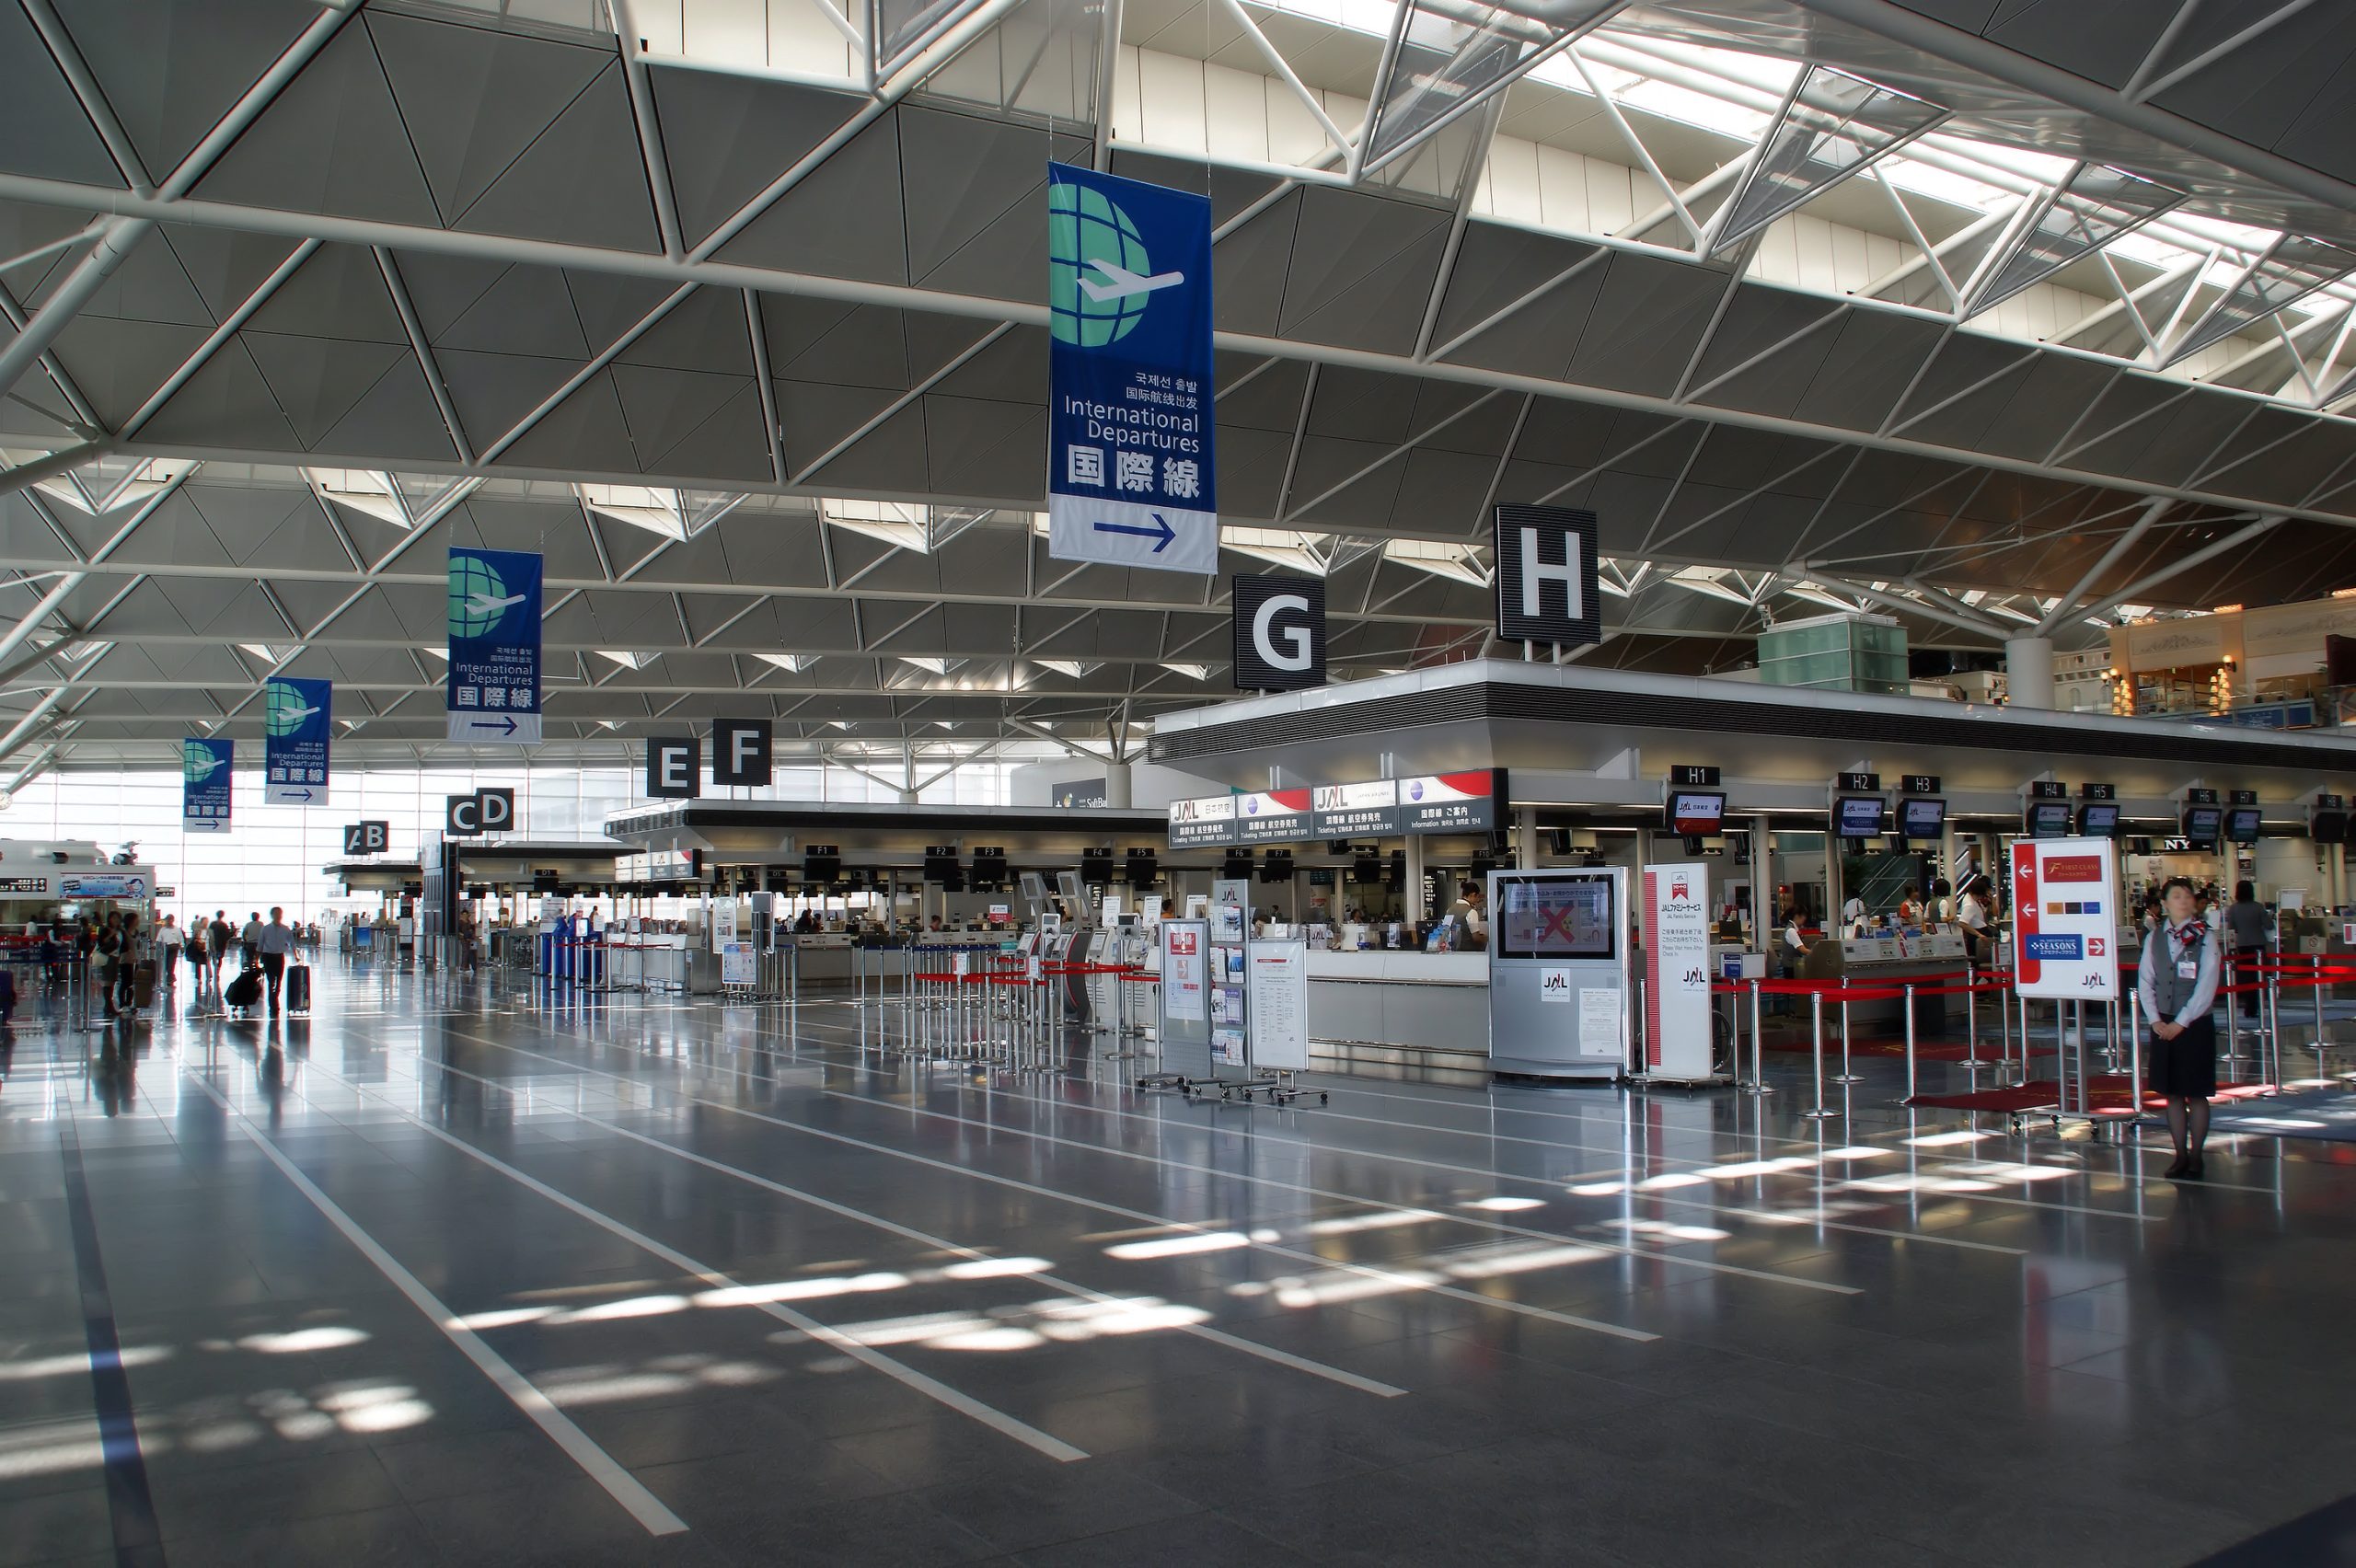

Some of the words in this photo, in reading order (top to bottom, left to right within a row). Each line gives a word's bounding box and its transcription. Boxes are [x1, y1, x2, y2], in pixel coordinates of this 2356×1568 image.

[1136, 372, 1171, 388] 국제선
[1175, 378, 1197, 394] 출발
[1126, 386, 1198, 410] 国际航线出发
[1065, 395, 1198, 433] International
[1088, 420, 1199, 454] Departures
[1068, 444, 1200, 499] 国際線
[1520, 527, 1583, 620] H
[1253, 594, 1312, 672] G
[456, 663, 533, 675] International
[468, 674, 533, 686] Departures
[456, 686, 533, 708] 国際線
[733, 730, 759, 773] F
[271, 768, 324, 782] 国際線
[662, 747, 688, 787] E
[1689, 767, 1704, 783] H1
[1853, 775, 1868, 790] H2
[1916, 778, 1930, 791] H3
[2045, 783, 2057, 796] H4
[2094, 785, 2106, 798] H5
[1087, 797, 1107, 808] SoftBa
[1318, 784, 1348, 810] JAL
[453, 801, 475, 829] C
[482, 794, 508, 824] D
[1174, 801, 1199, 822] JAL
[1679, 801, 1692, 812] JAL
[348, 829, 361, 850] A
[367, 825, 384, 847] B
[817, 847, 827, 855] F1
[1137, 848, 1146, 857] F5
[1222, 887, 1237, 904] JAL
[1311, 929, 1325, 942] JAL
[2039, 941, 2076, 950] SEASONS
[1543, 974, 1567, 992] JAL
[1683, 967, 1705, 986] JAL
[2082, 972, 2106, 988] JAL
